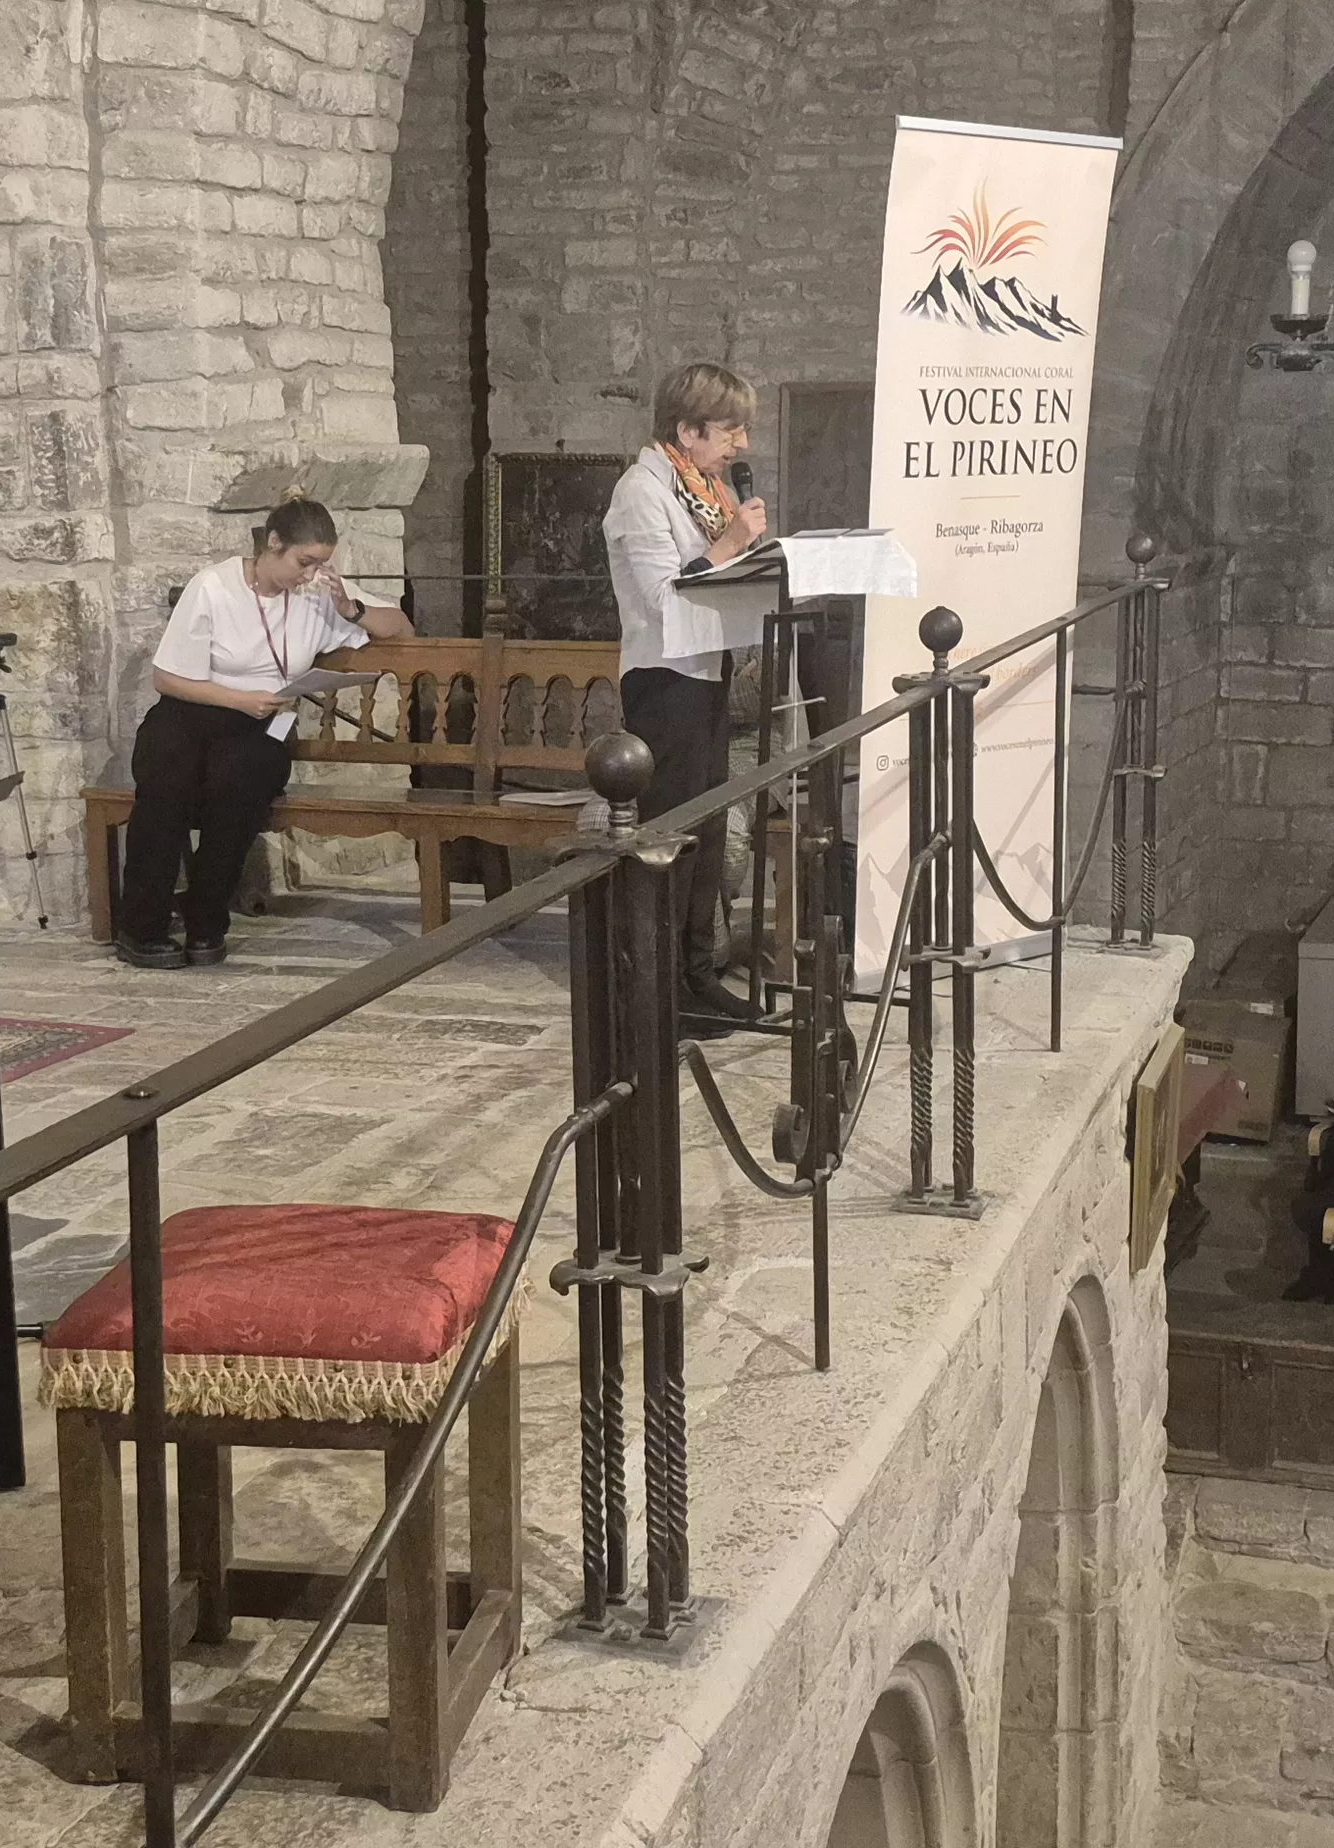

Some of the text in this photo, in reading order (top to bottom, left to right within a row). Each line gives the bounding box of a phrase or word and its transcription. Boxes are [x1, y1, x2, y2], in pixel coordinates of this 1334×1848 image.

[919, 365, 1073, 379] FESTIVAL INTERNACIONAL CORAL
[918, 388, 1073, 425] VOCES EN
[903, 438, 1078, 478] EL PIRINEO
[935, 523, 981, 540] Benasque
[990, 518, 1044, 538] Ribagorza
[987, 540, 1019, 556] España)
